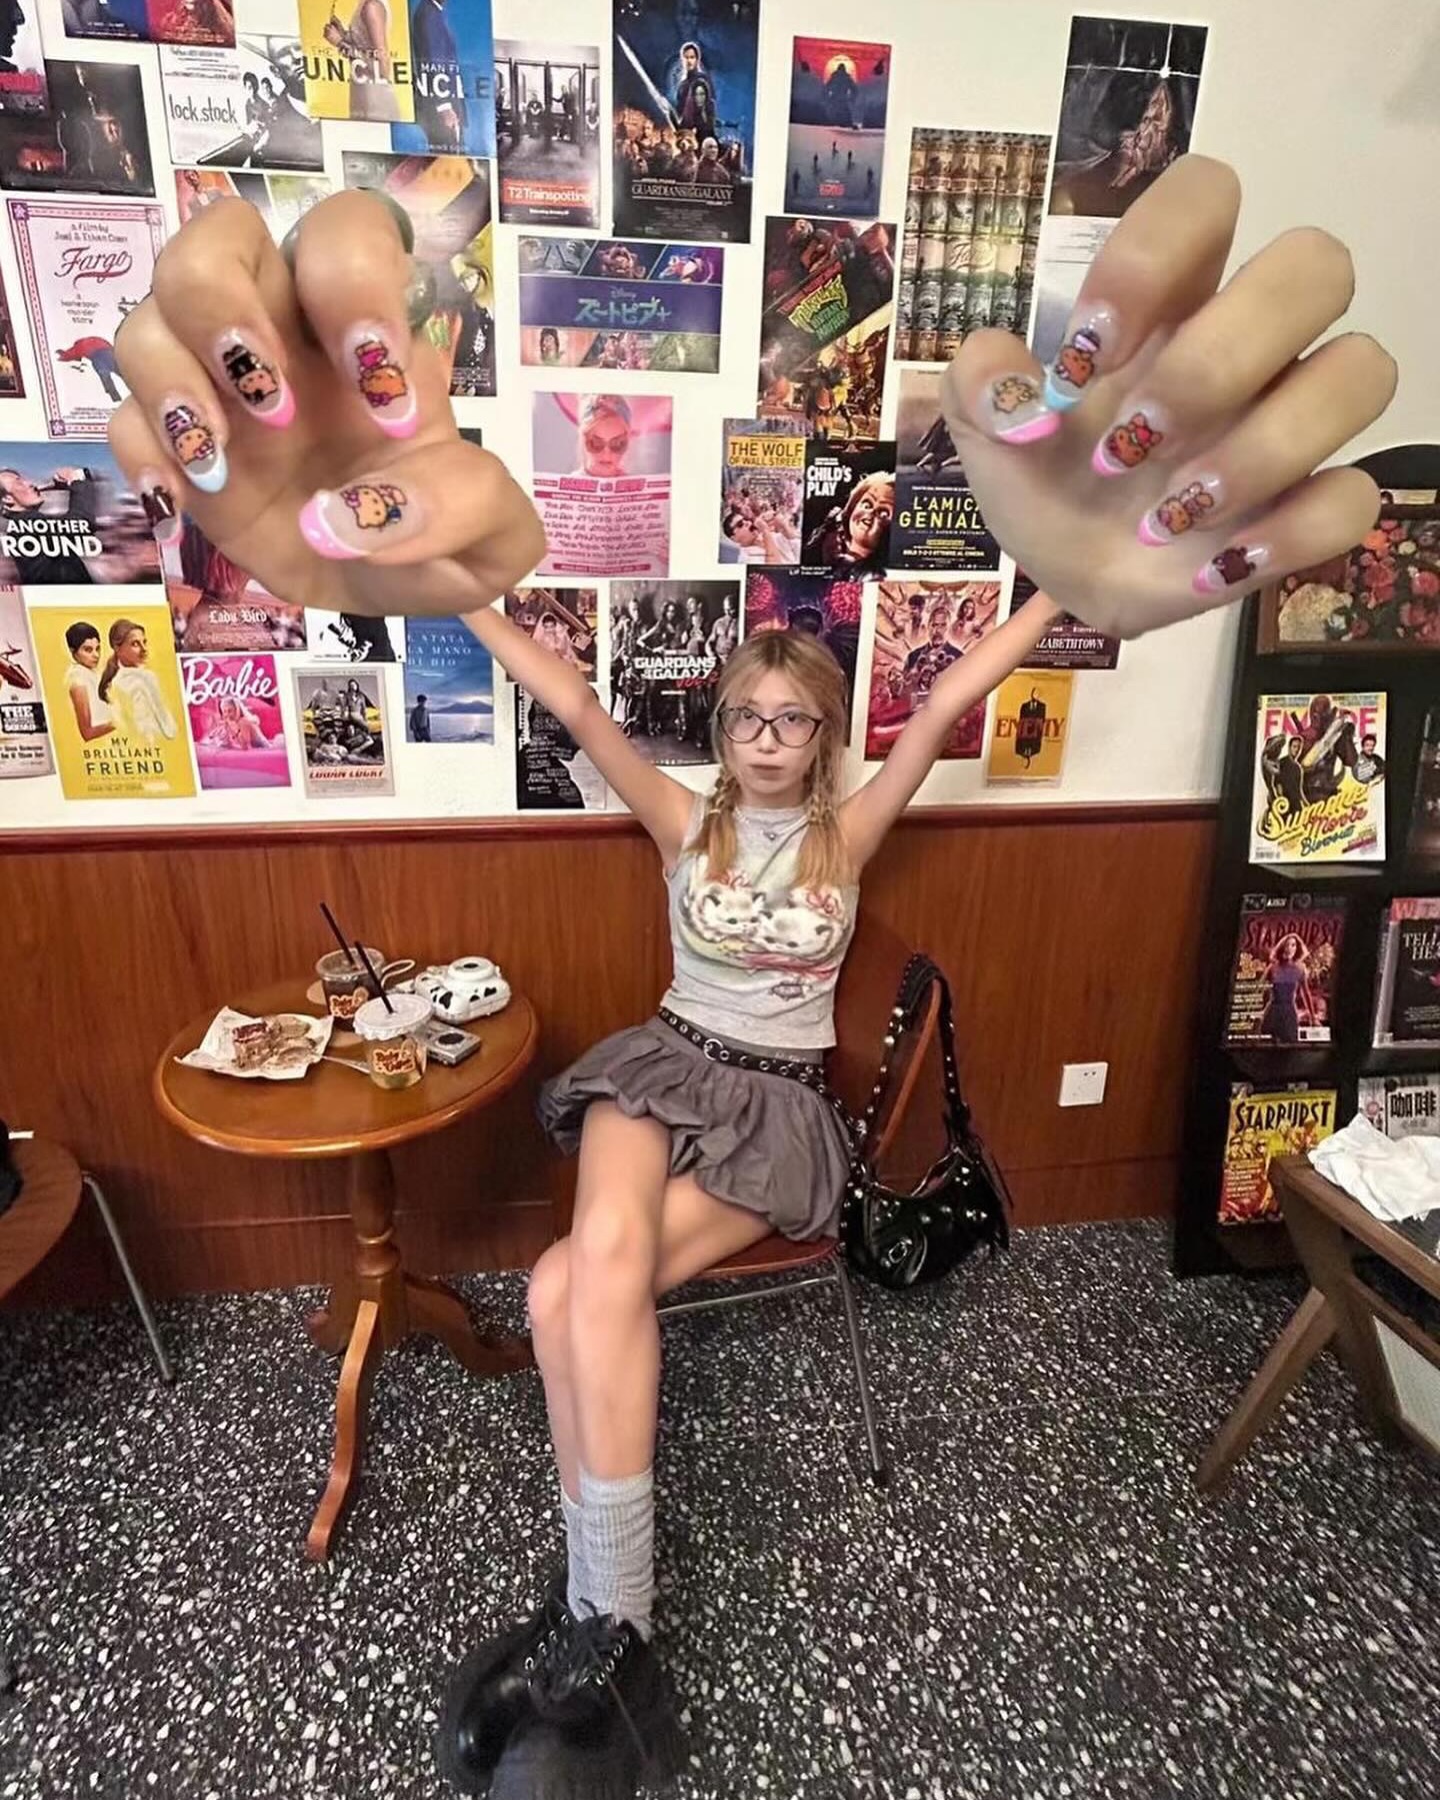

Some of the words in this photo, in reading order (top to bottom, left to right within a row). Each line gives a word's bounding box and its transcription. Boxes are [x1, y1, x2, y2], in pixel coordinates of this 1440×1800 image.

[54, 246, 133, 289] Fargo
[730, 441, 758, 457] THE
[762, 443, 804, 458] WOLF
[729, 456, 739, 465] OF
[742, 456, 767, 466] WALL
[806, 465, 853, 483] CHILD'S
[806, 482, 839, 500] PLAY
[6, 519, 91, 534] ANOTHER
[898, 511, 983, 530] GENIAL
[0, 535, 103, 558] ROUND
[1035, 637, 1105, 650] ZABETHTOWN
[634, 655, 717, 669] GUARDIANS
[183, 657, 279, 706] Barbie
[652, 668, 714, 680] GALAXY
[1, 705, 34, 718] THE
[995, 717, 1065, 739] ENEMY
[111, 737, 129, 746] MY
[83, 747, 162, 760] BRILLIANT
[86, 761, 165, 776] FRIEND
[1389, 1090, 1437, 1119] 咖啡
[1235, 1100, 1332, 1134] STARBURST
